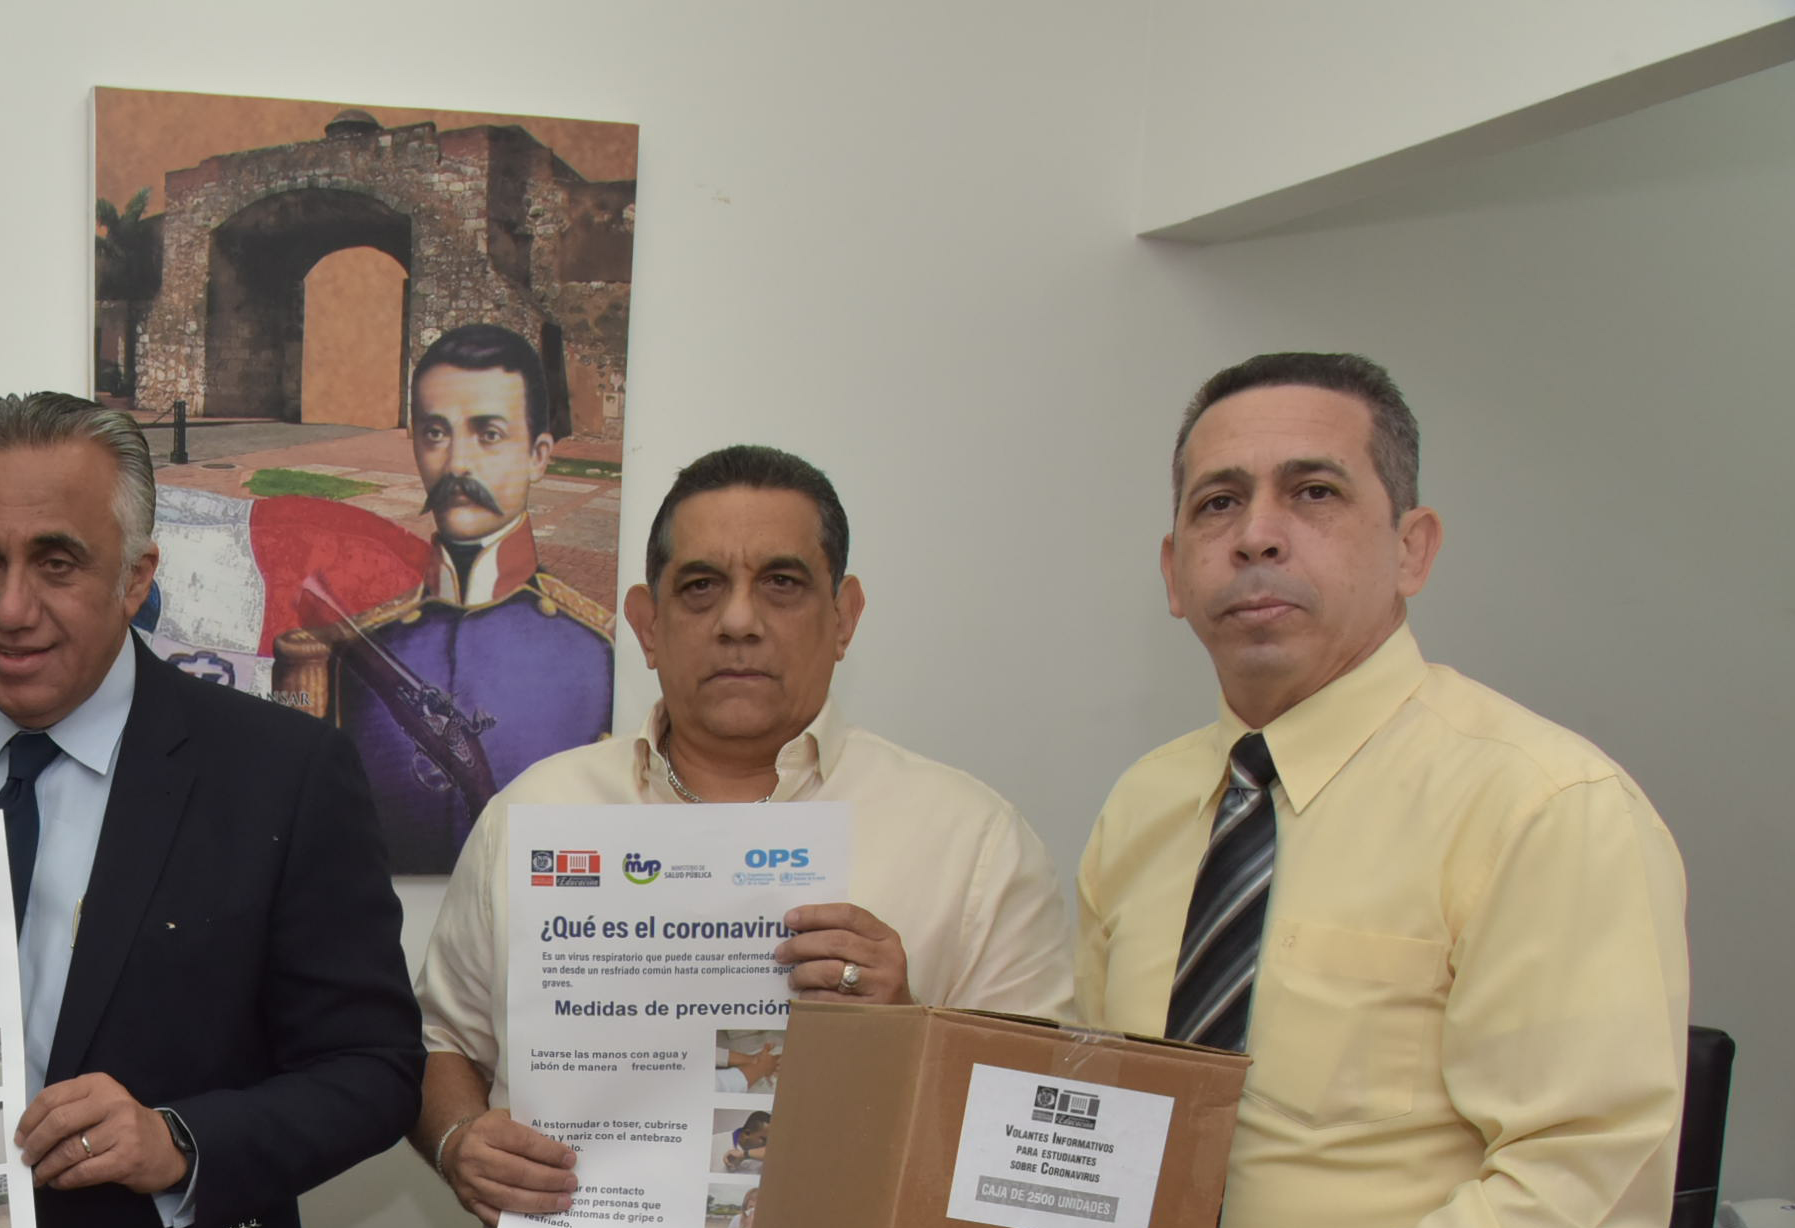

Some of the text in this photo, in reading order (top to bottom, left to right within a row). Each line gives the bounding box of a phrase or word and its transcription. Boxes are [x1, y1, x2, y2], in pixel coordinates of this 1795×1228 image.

[745, 849, 809, 868] OPS
[541, 915, 596, 942] ¿Qué
[602, 921, 629, 938] es
[635, 916, 655, 938] el
[555, 1000, 638, 1016] Medidas
[645, 1000, 669, 1016] de
[531, 1049, 571, 1059] Lavarse
[575, 1050, 589, 1059] las
[630, 1051, 650, 1059] con
[652, 1051, 679, 1061] agua
[682, 1051, 688, 1059] y
[1006, 1124, 1115, 1154] VOLANTES INFORMATIVOS
[1016, 1145, 1097, 1166] PARA ESTUDIANTES
[1010, 1159, 1100, 1183] SOBRE CORONAVIRUS
[981, 1183, 1111, 1215] CAJA DE 2500 UNIDADES
